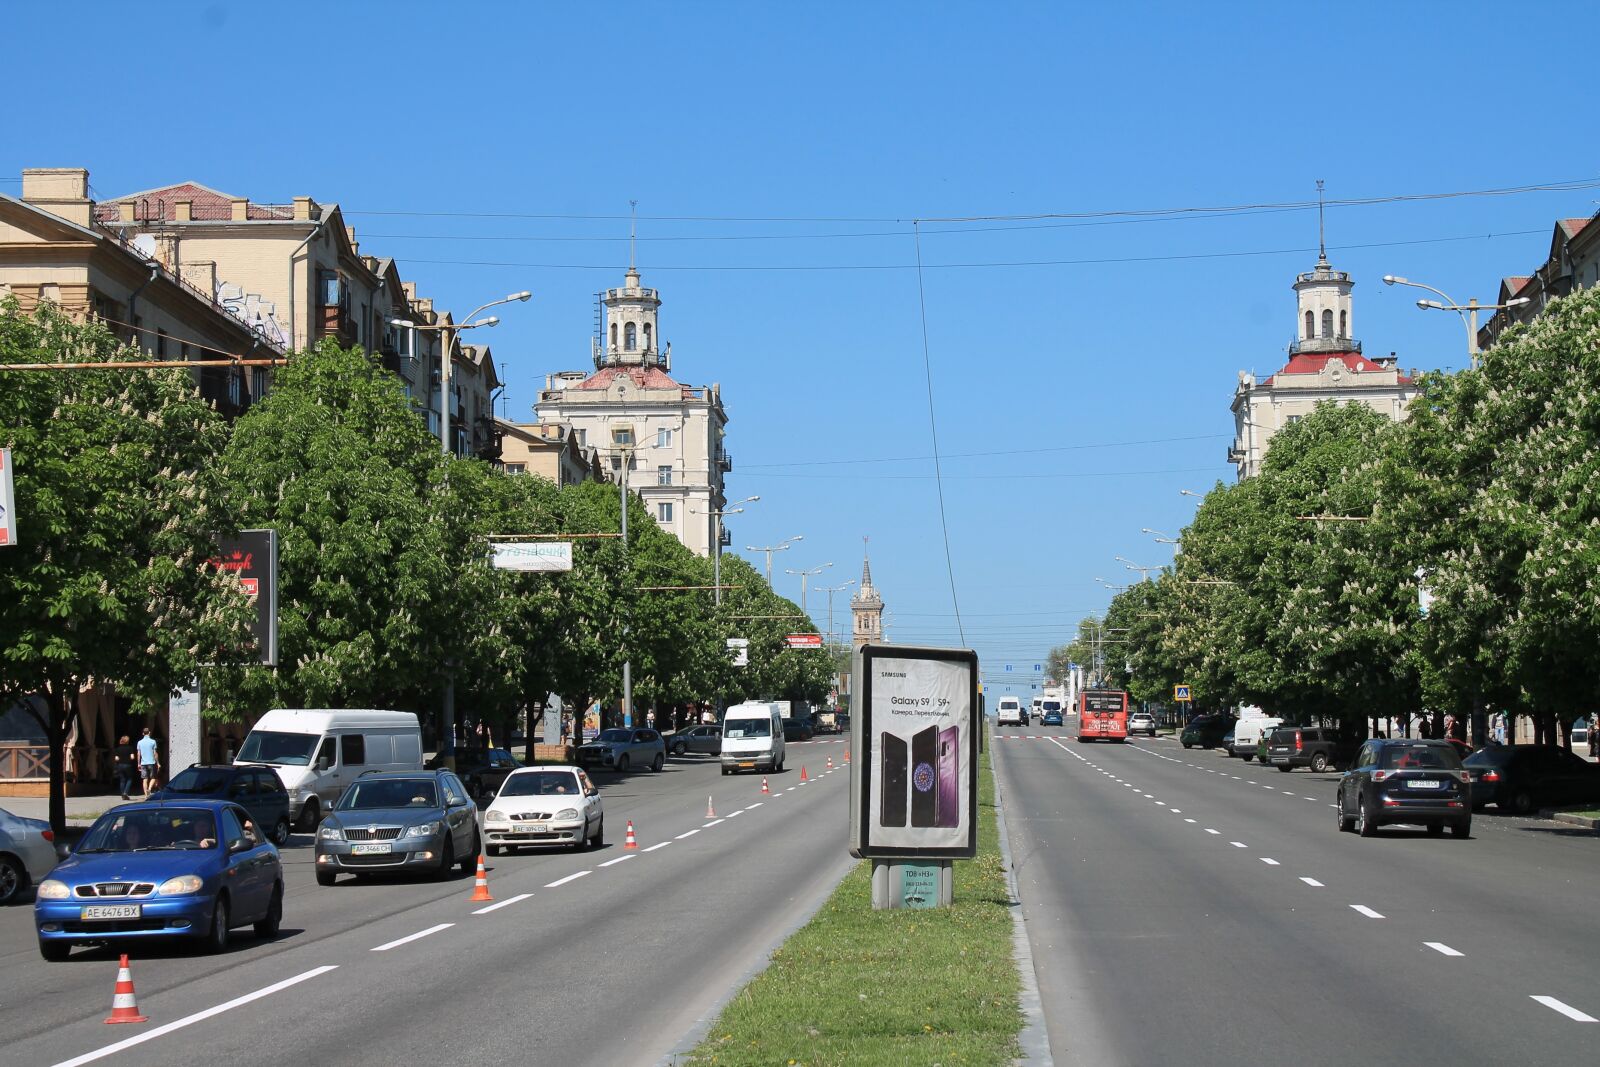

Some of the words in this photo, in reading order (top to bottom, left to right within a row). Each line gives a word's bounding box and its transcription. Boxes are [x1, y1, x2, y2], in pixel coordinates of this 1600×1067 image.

[891, 696, 919, 707] Galaxy
[921, 697, 930, 706] S9
[938, 698, 950, 707] S9+
[87, 908, 100, 918] AE
[102, 907, 122, 917] 6476
[124, 906, 137, 917] BX
